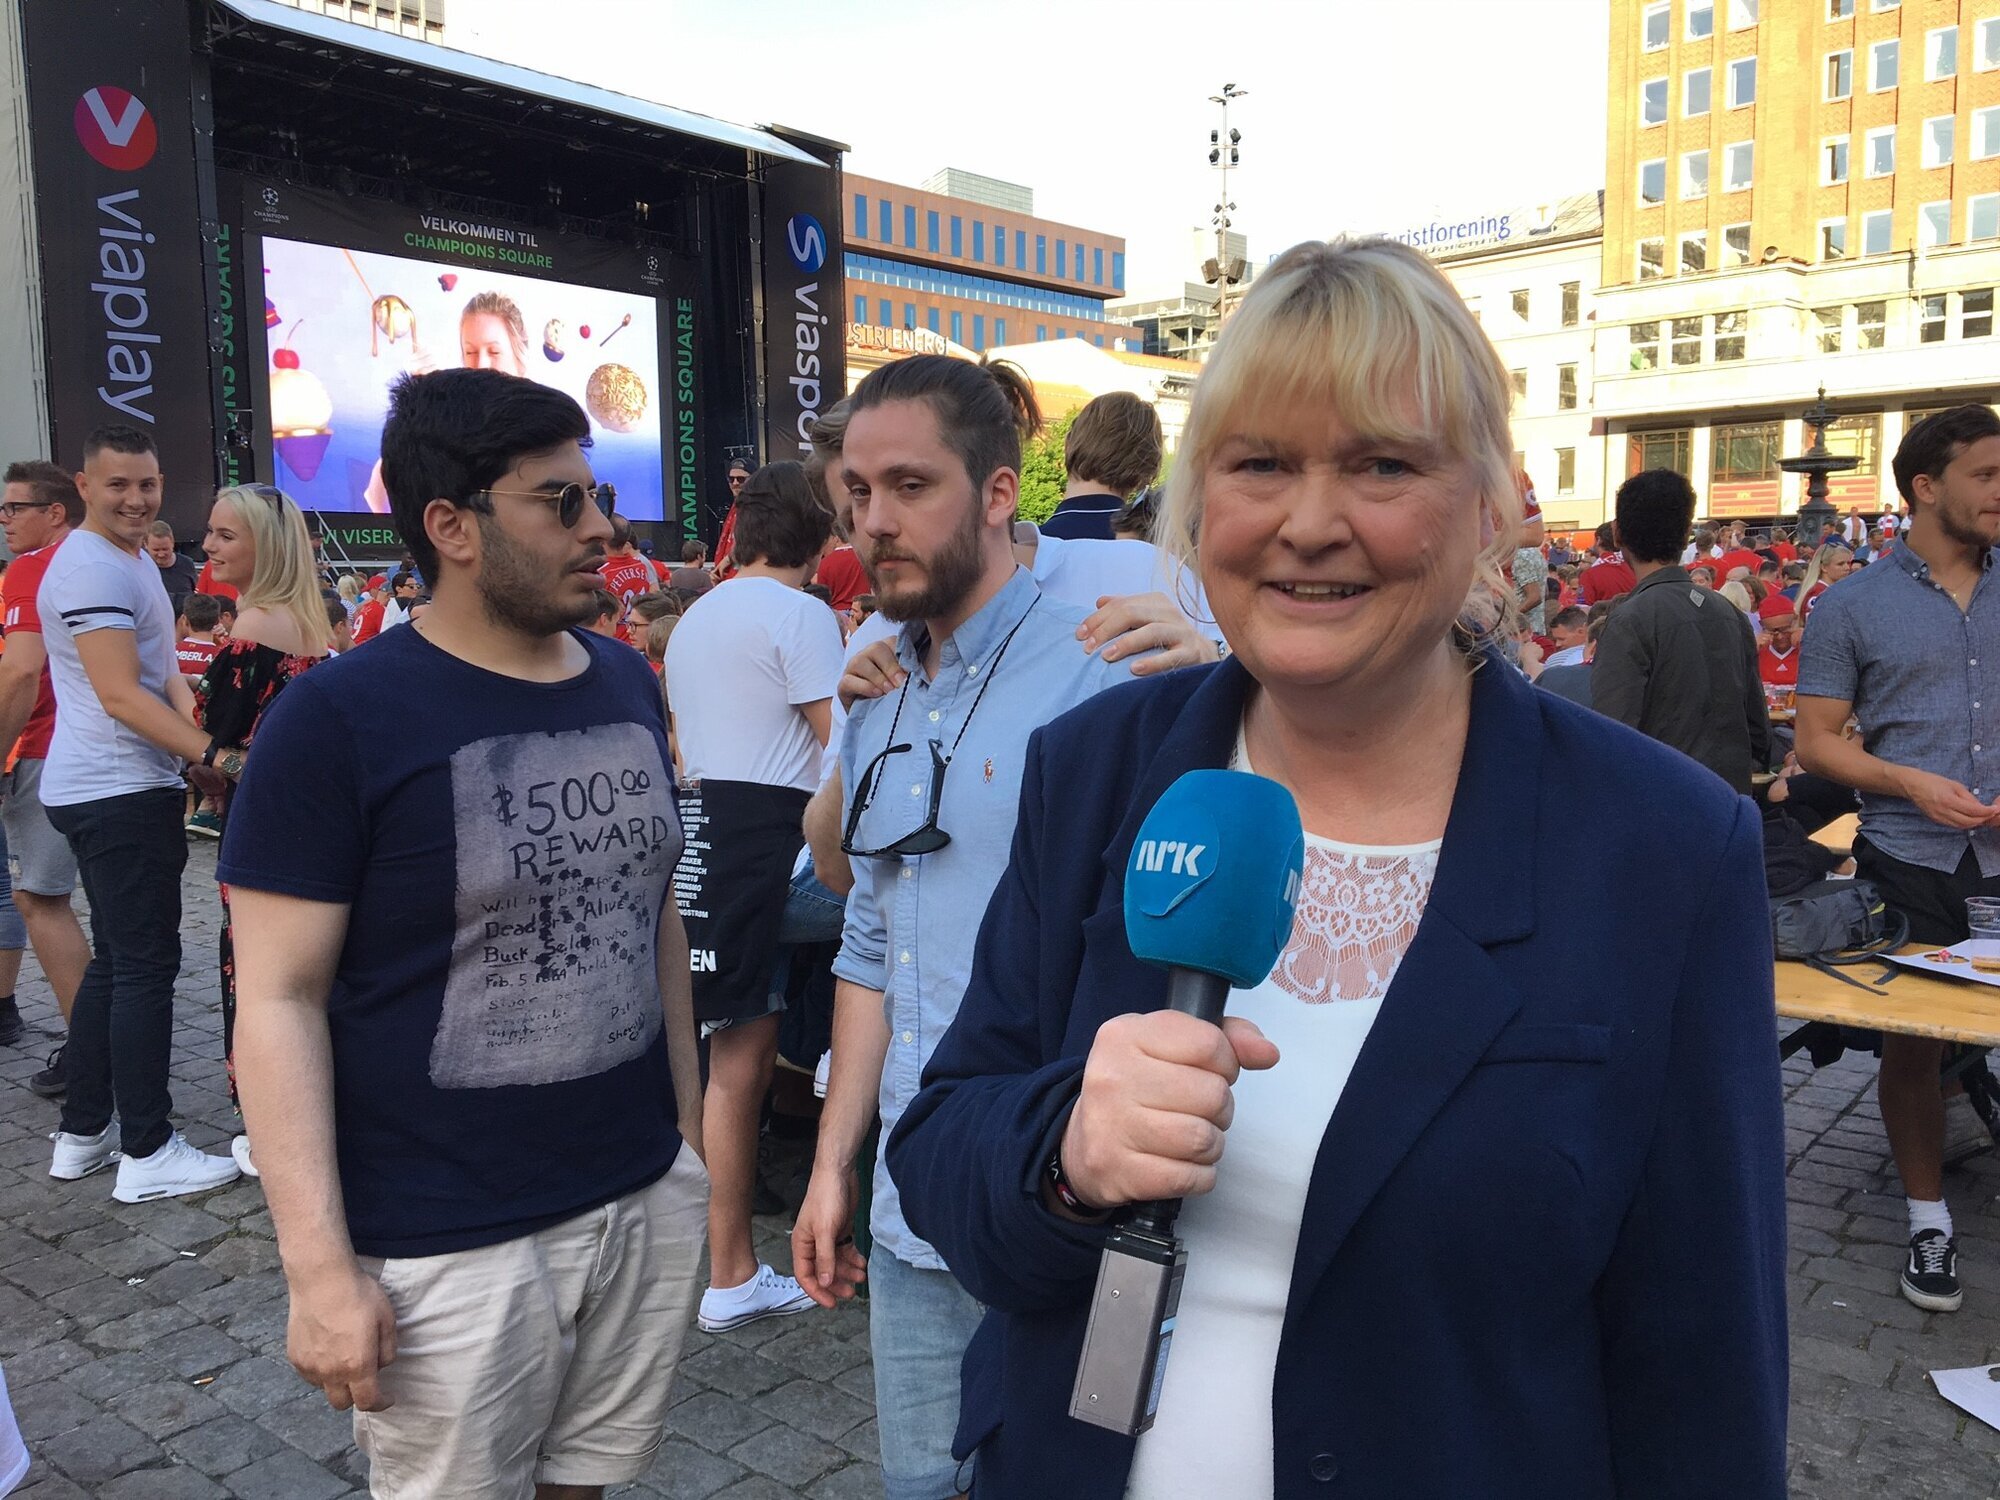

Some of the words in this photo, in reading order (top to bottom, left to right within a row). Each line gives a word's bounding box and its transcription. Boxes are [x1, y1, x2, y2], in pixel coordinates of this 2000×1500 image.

[420, 215, 515, 243] VELKOMMEN
[517, 232, 539, 248] TIL
[404, 233, 496, 259] CHAMPIONS
[498, 247, 553, 269] SQUARE
[90, 188, 162, 425] viaplay
[677, 298, 694, 405] SQUARE
[342, 529, 395, 544] VISER
[508, 816, 669, 880] REWARD
[485, 913, 537, 939] Dead
[483, 946, 529, 964] Buck
